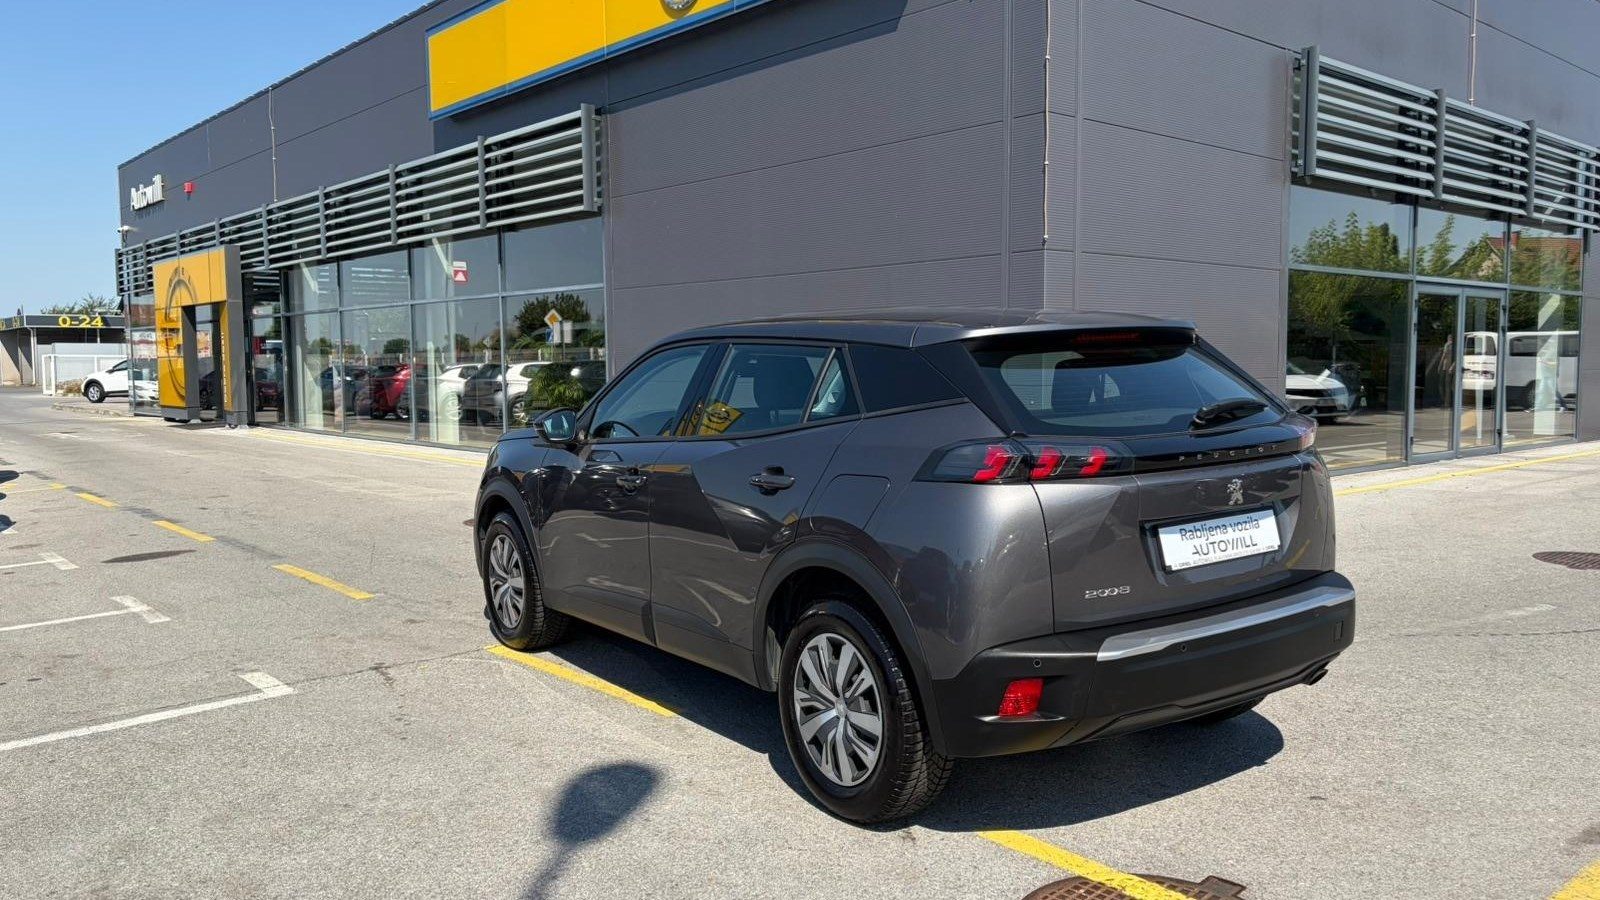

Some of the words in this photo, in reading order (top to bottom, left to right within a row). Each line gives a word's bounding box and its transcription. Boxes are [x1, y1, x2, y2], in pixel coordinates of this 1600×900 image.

[58, 315, 104, 328] 0-24
[1179, 444, 1278, 462] PEUGEOT
[1180, 521, 1228, 541] Rabljena
[1228, 516, 1260, 533] vozila
[1192, 535, 1258, 557] AUTOWILL
[1085, 585, 1130, 599] 2008
